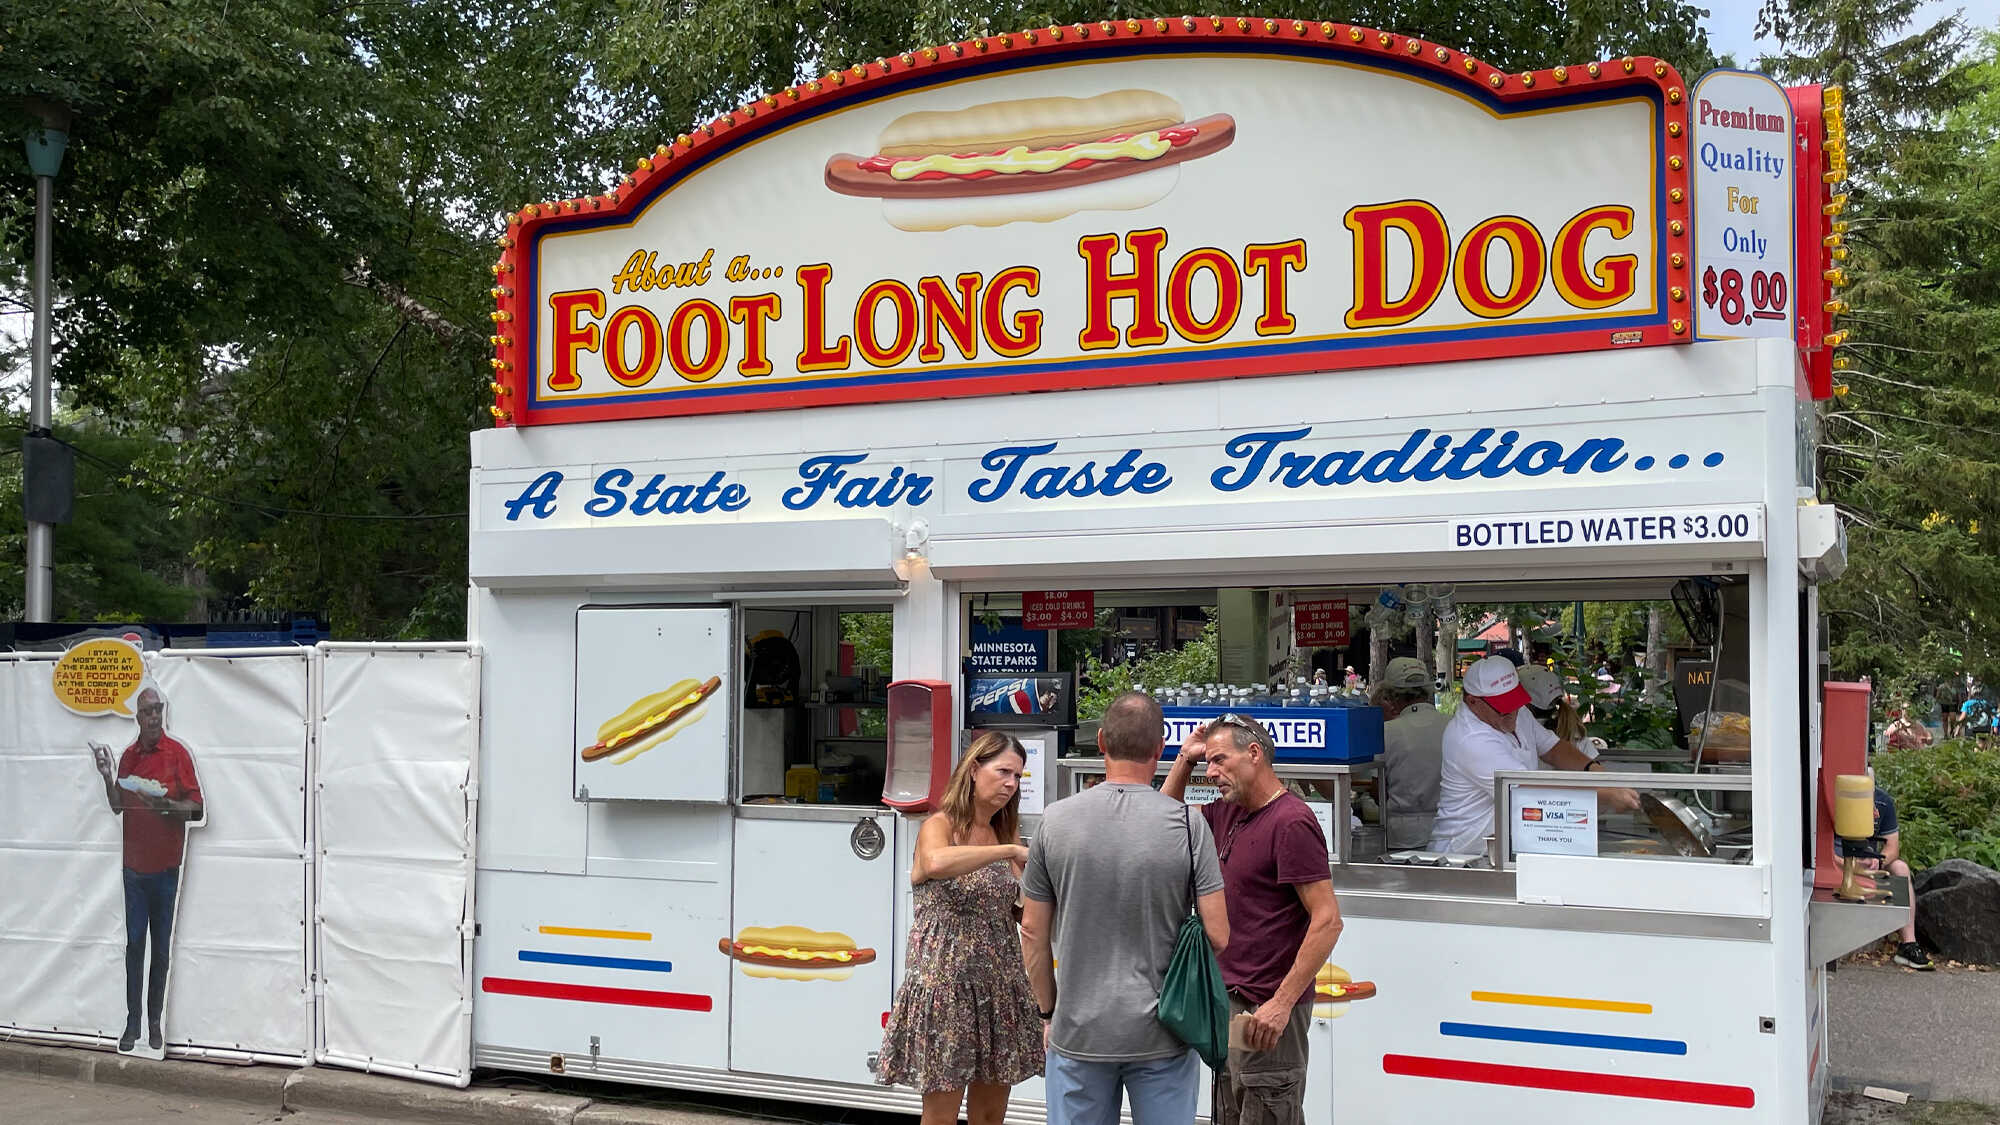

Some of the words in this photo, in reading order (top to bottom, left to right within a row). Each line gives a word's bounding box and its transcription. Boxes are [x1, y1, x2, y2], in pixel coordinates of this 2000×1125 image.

[1700, 99, 1785, 133] Premium
[1701, 142, 1784, 179] Quality
[1727, 187, 1759, 214] For
[1723, 227, 1767, 259] Only
[612, 249, 713, 294] About
[725, 254, 784, 282] a...
[548, 288, 781, 391] FOOT
[797, 263, 1043, 373] LONG
[1078, 227, 1306, 351] HOT
[1344, 200, 1638, 329] DOG
[1703, 265, 1787, 325] $8.00
[505, 471, 564, 521] A
[584, 468, 751, 518] State
[782, 453, 934, 510] Fair
[967, 441, 1172, 503] Taste
[1210, 426, 1725, 493] Tradition...
[1456, 520, 1573, 547] BOTTLED
[1581, 516, 1676, 542] WATER
[1683, 514, 1749, 538] $3.00
[1026, 612, 1052, 622] $3.00
[1061, 611, 1088, 621] $4.00
[971, 656, 1003, 666] STATE
[1004, 656, 1038, 666] PARKS
[973, 643, 1037, 652] MINNESOTA
[56, 672, 83, 680] FAVE
[86, 672, 140, 680] FOOTLONG
[67, 688, 109, 696] CARNES
[74, 696, 115, 704] NELSON
[970, 678, 1028, 712] PEPSI
[1260, 721, 1322, 743] ATER
